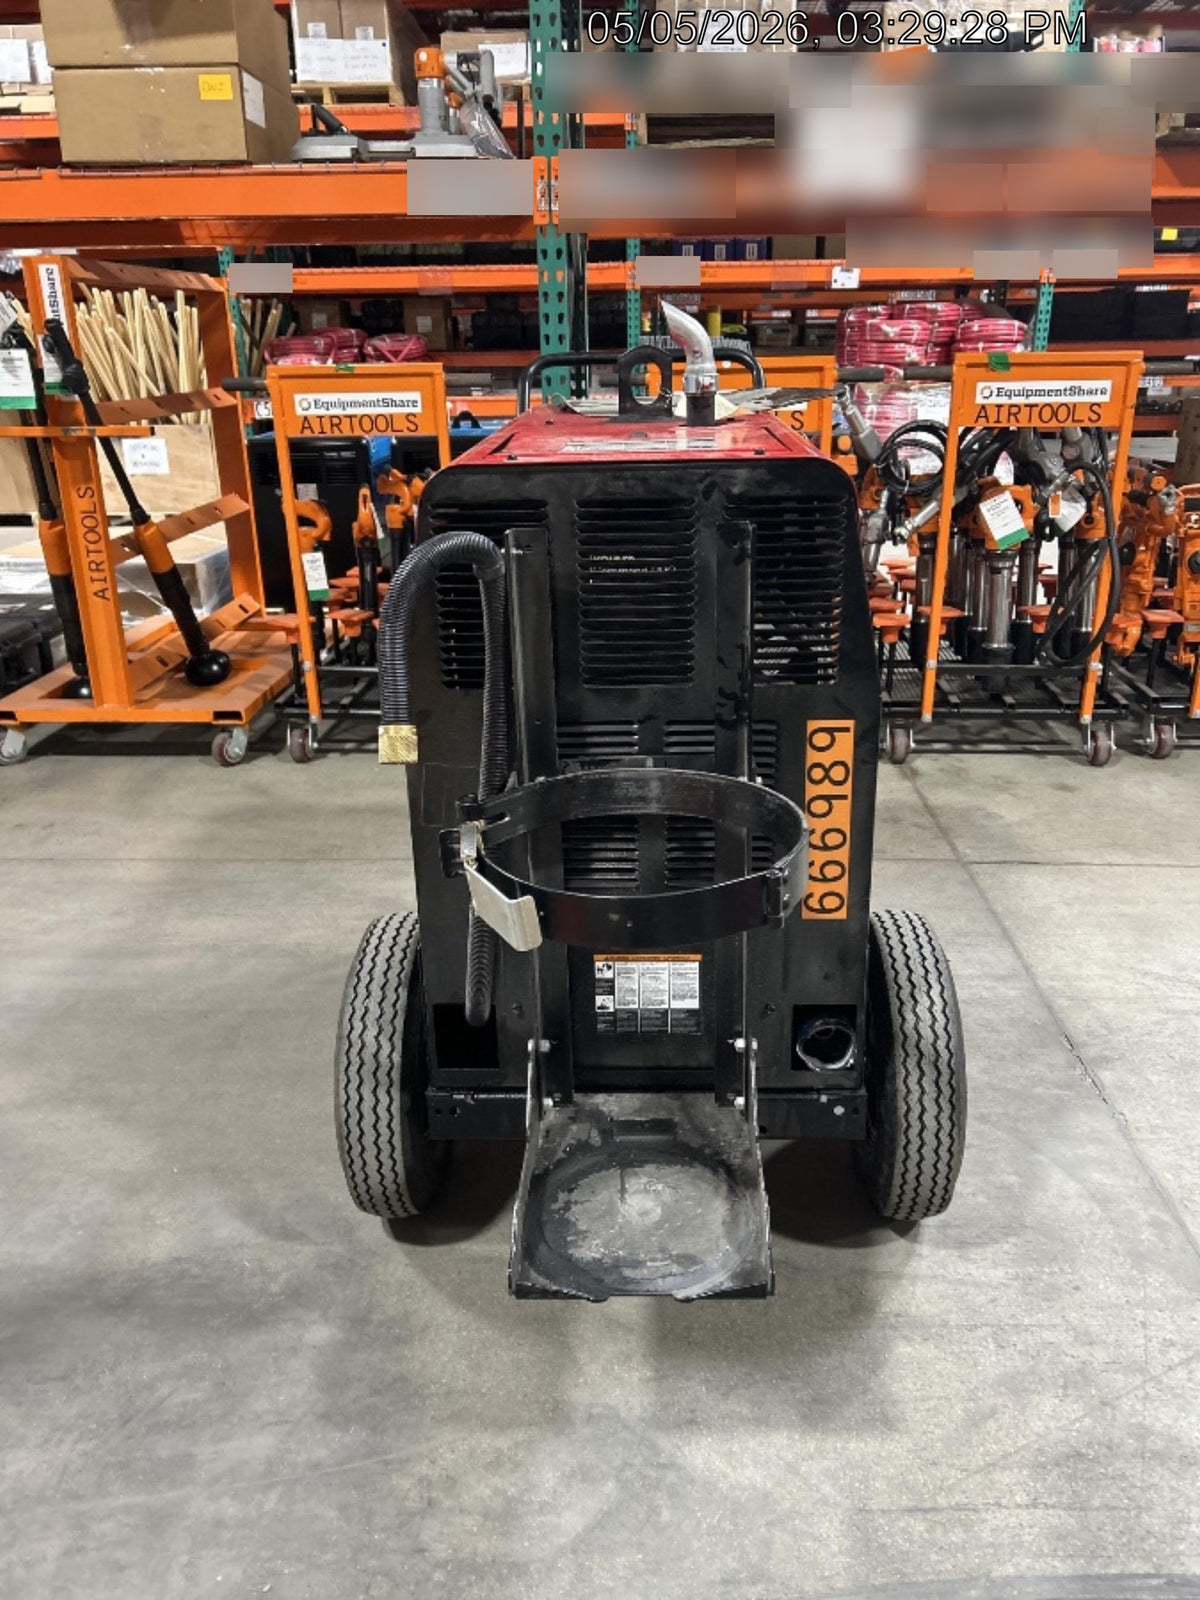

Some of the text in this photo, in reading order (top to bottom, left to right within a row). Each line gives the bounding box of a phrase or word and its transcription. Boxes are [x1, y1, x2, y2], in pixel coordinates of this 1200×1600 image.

[995, 384, 1107, 399] EquipmentShare
[313, 397, 419, 411] EquipmentShare
[974, 403, 1102, 424] AIRTOOLS
[300, 413, 419, 435] AIRTOOLS
[76, 486, 111, 602] AIRTOOLS
